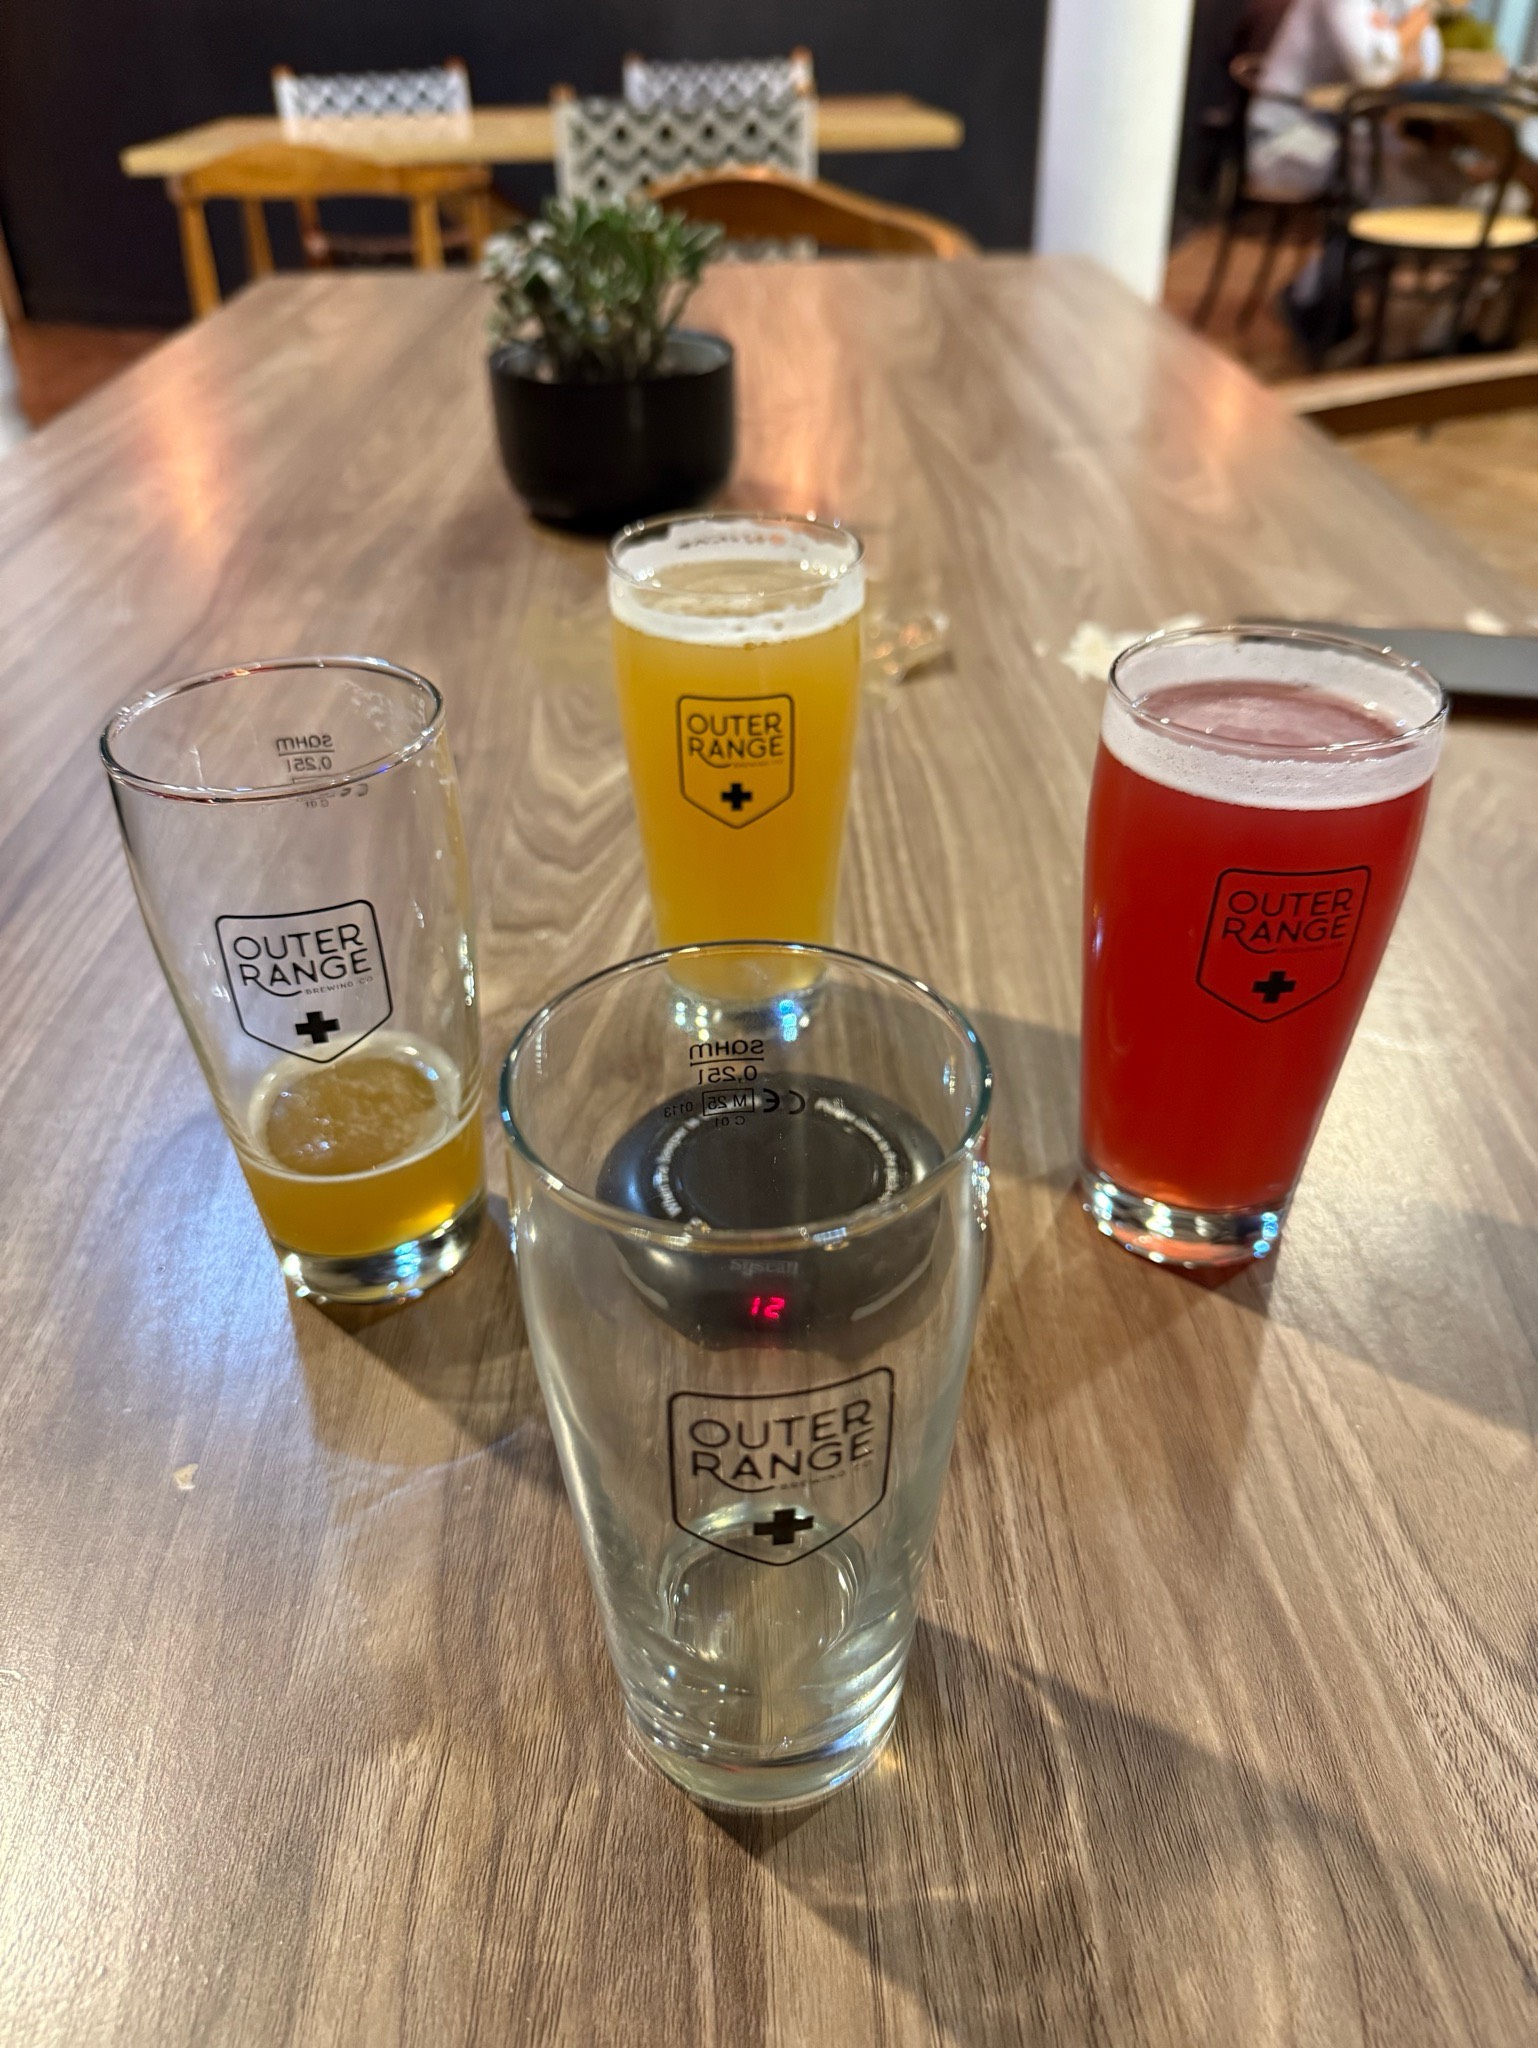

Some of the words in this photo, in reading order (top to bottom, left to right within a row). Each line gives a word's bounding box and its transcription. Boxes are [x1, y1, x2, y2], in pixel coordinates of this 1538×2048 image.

[687, 712, 782, 736] OUTER
[688, 735, 784, 768] RANGE
[1228, 888, 1353, 917] OUTER
[233, 923, 364, 960] OUTER
[1221, 913, 1351, 954] RANGE
[239, 948, 372, 997] RANGE
[306, 981, 354, 995] BREWING
[751, 1296, 785, 1319] 12
[689, 1399, 872, 1449] OUTER
[692, 1427, 874, 1492] RANGE
